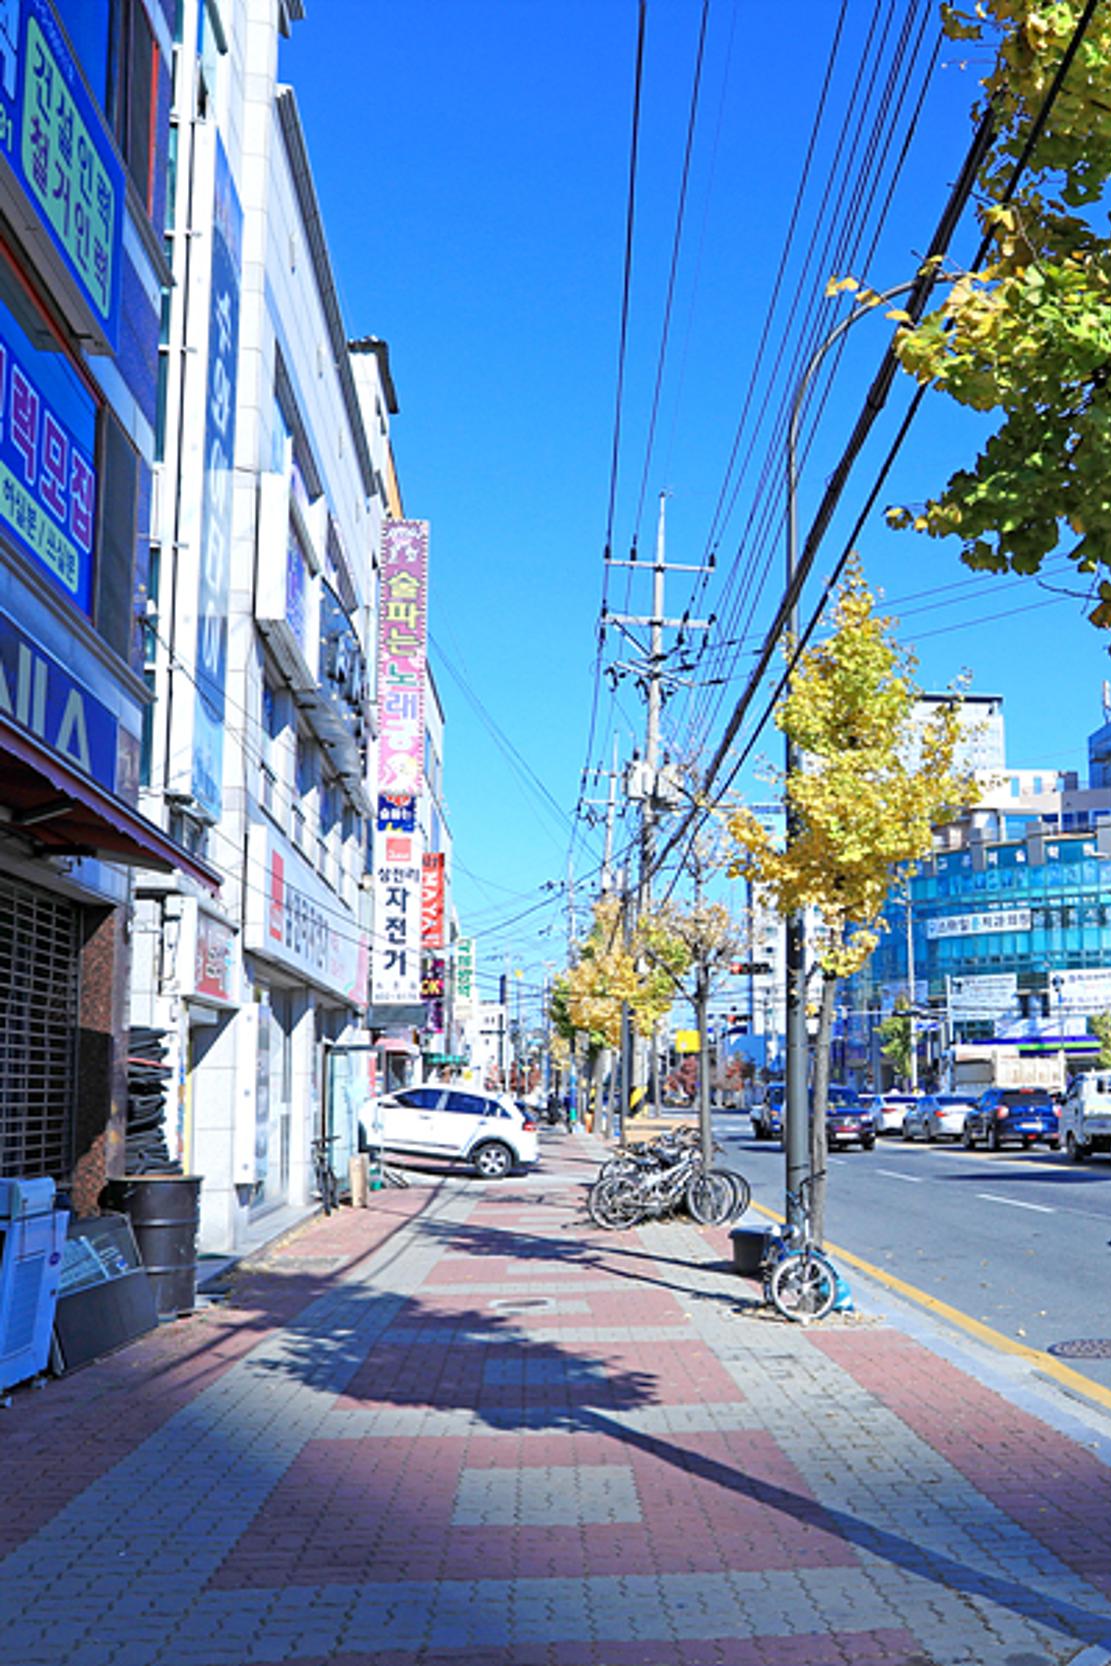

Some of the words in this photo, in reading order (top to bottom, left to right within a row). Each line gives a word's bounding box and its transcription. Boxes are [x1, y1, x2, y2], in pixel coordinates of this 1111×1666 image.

[31, 115, 108, 307] 철거인력
[34, 41, 111, 243] 건설인력
[0, 343, 94, 554] 력모집
[378, 868, 420, 883] 삼천리
[384, 887, 410, 976] 자전거
